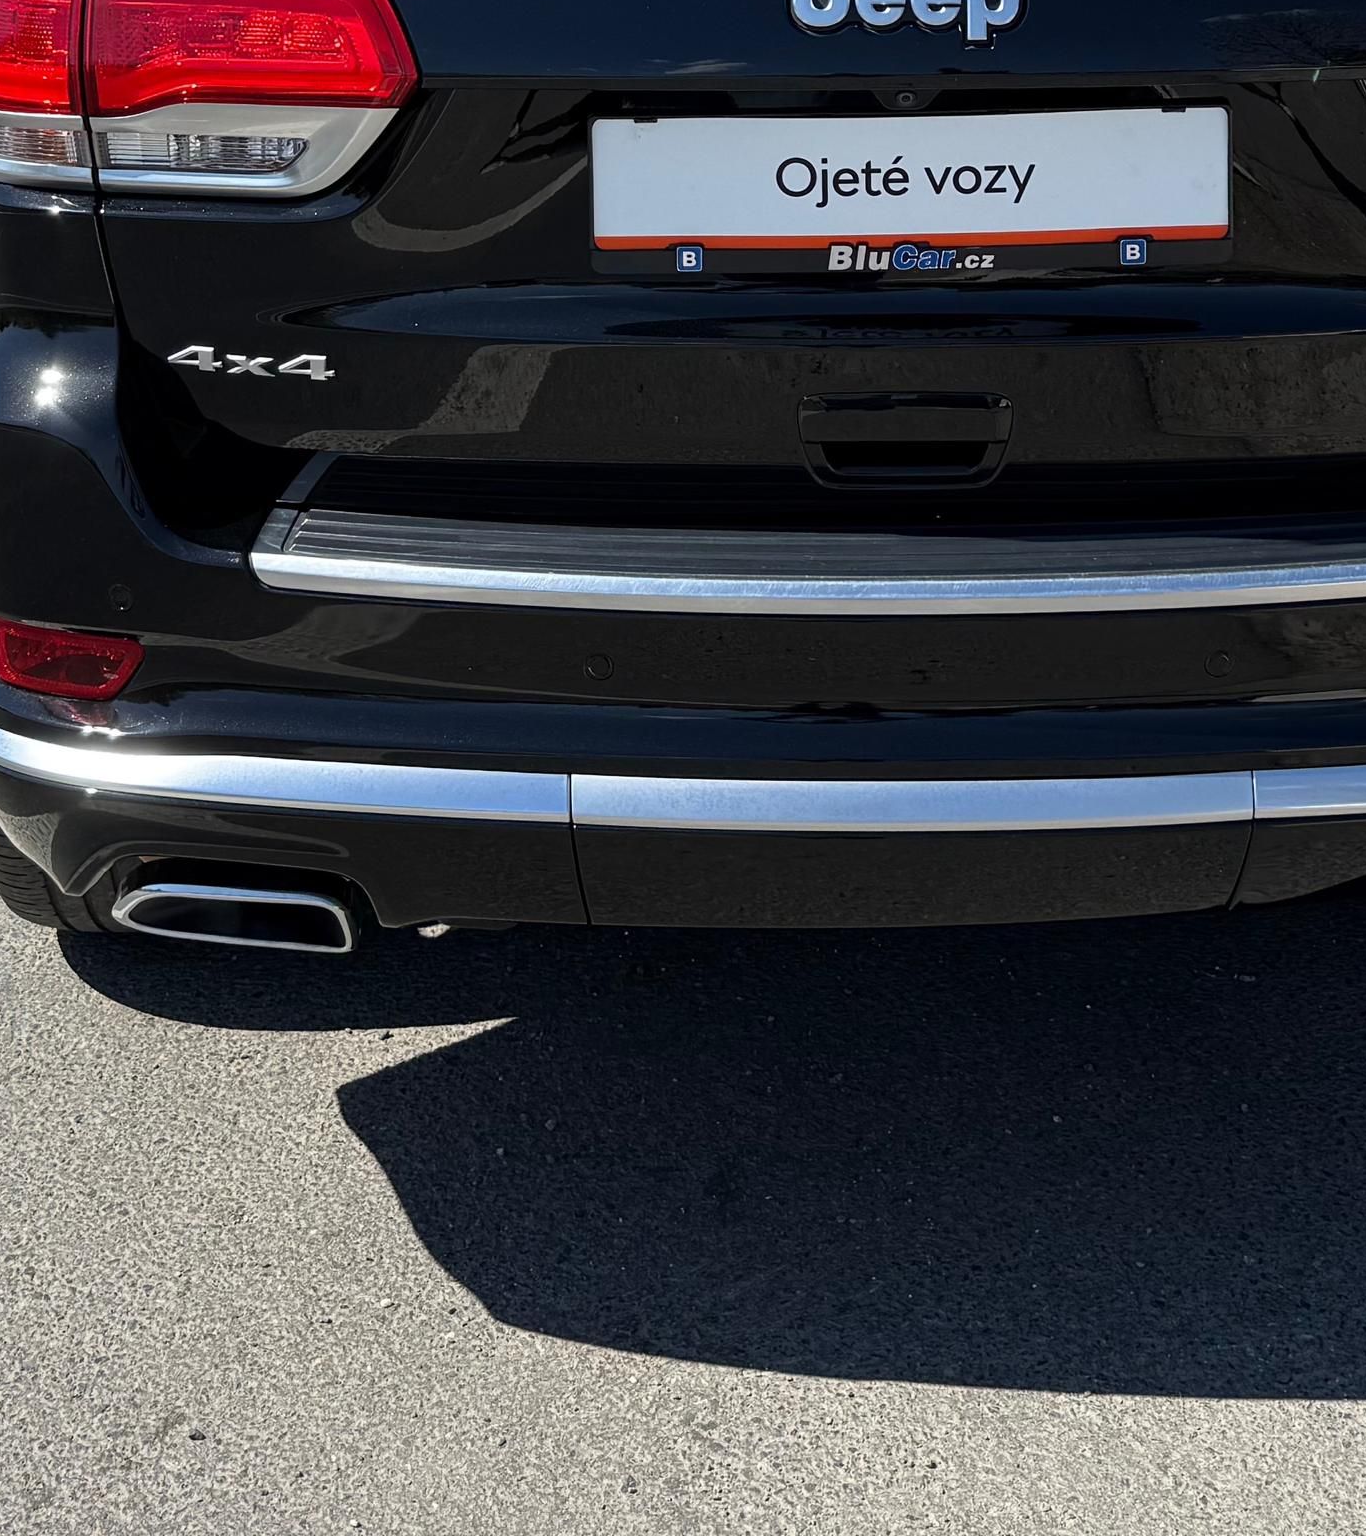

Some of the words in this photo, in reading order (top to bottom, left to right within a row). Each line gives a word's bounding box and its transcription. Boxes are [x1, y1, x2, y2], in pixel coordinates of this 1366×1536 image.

[775, 155, 910, 209] Ojeté
[923, 163, 1036, 204] vozy
[828, 245, 995, 272] BluCar.cz
[167, 345, 336, 381] 4x4
